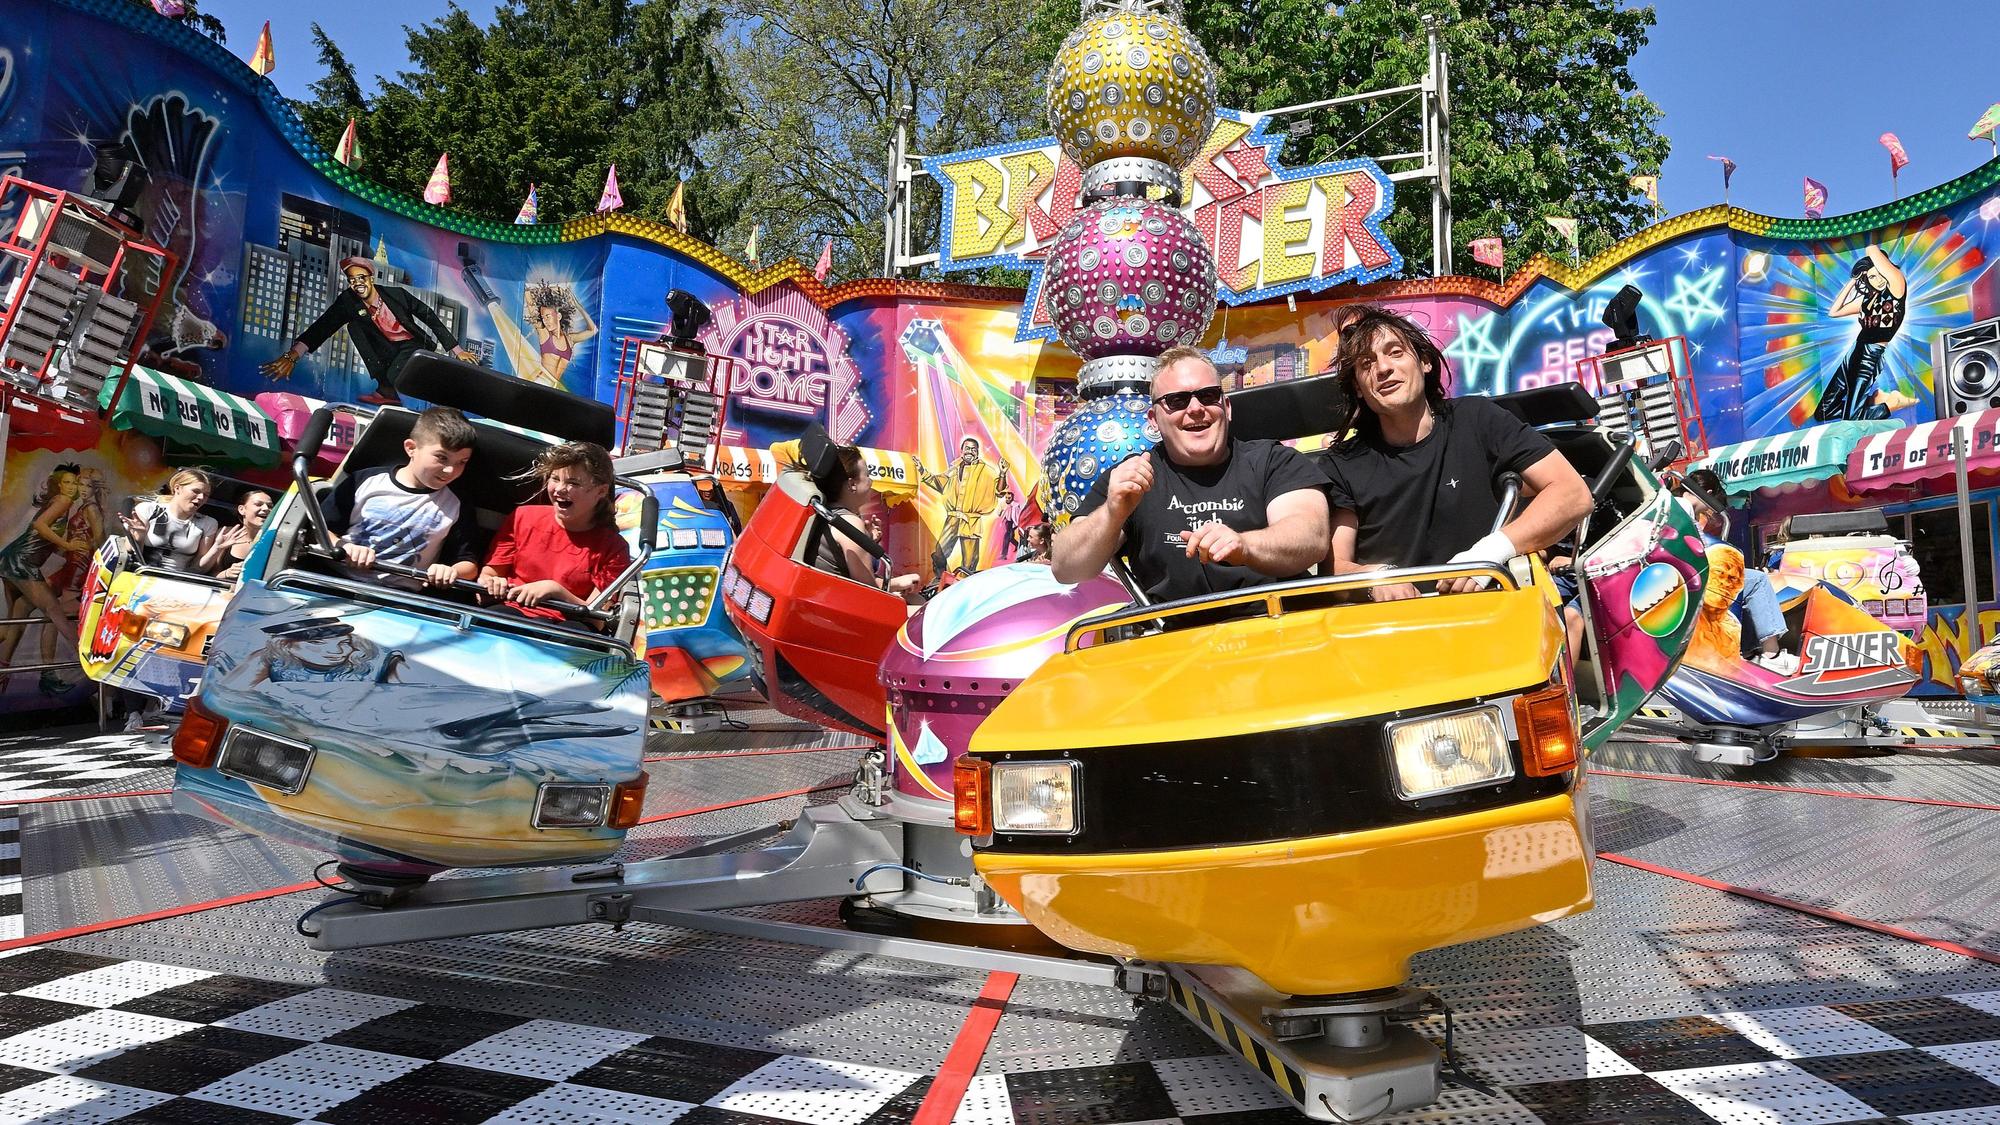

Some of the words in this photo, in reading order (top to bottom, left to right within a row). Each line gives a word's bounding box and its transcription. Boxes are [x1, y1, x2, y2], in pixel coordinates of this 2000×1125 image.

[745, 335, 823, 371] LIGHT
[731, 357, 846, 405] DOME
[149, 391, 170, 415] NO
[176, 400, 209, 426] RISK
[212, 404, 231, 432] NO
[236, 421, 261, 441] FUN
[716, 462, 753, 478] KRASS
[1741, 444, 1810, 476] GENERATION
[1909, 447, 1929, 462] OF
[1801, 631, 1904, 673] SILVER
